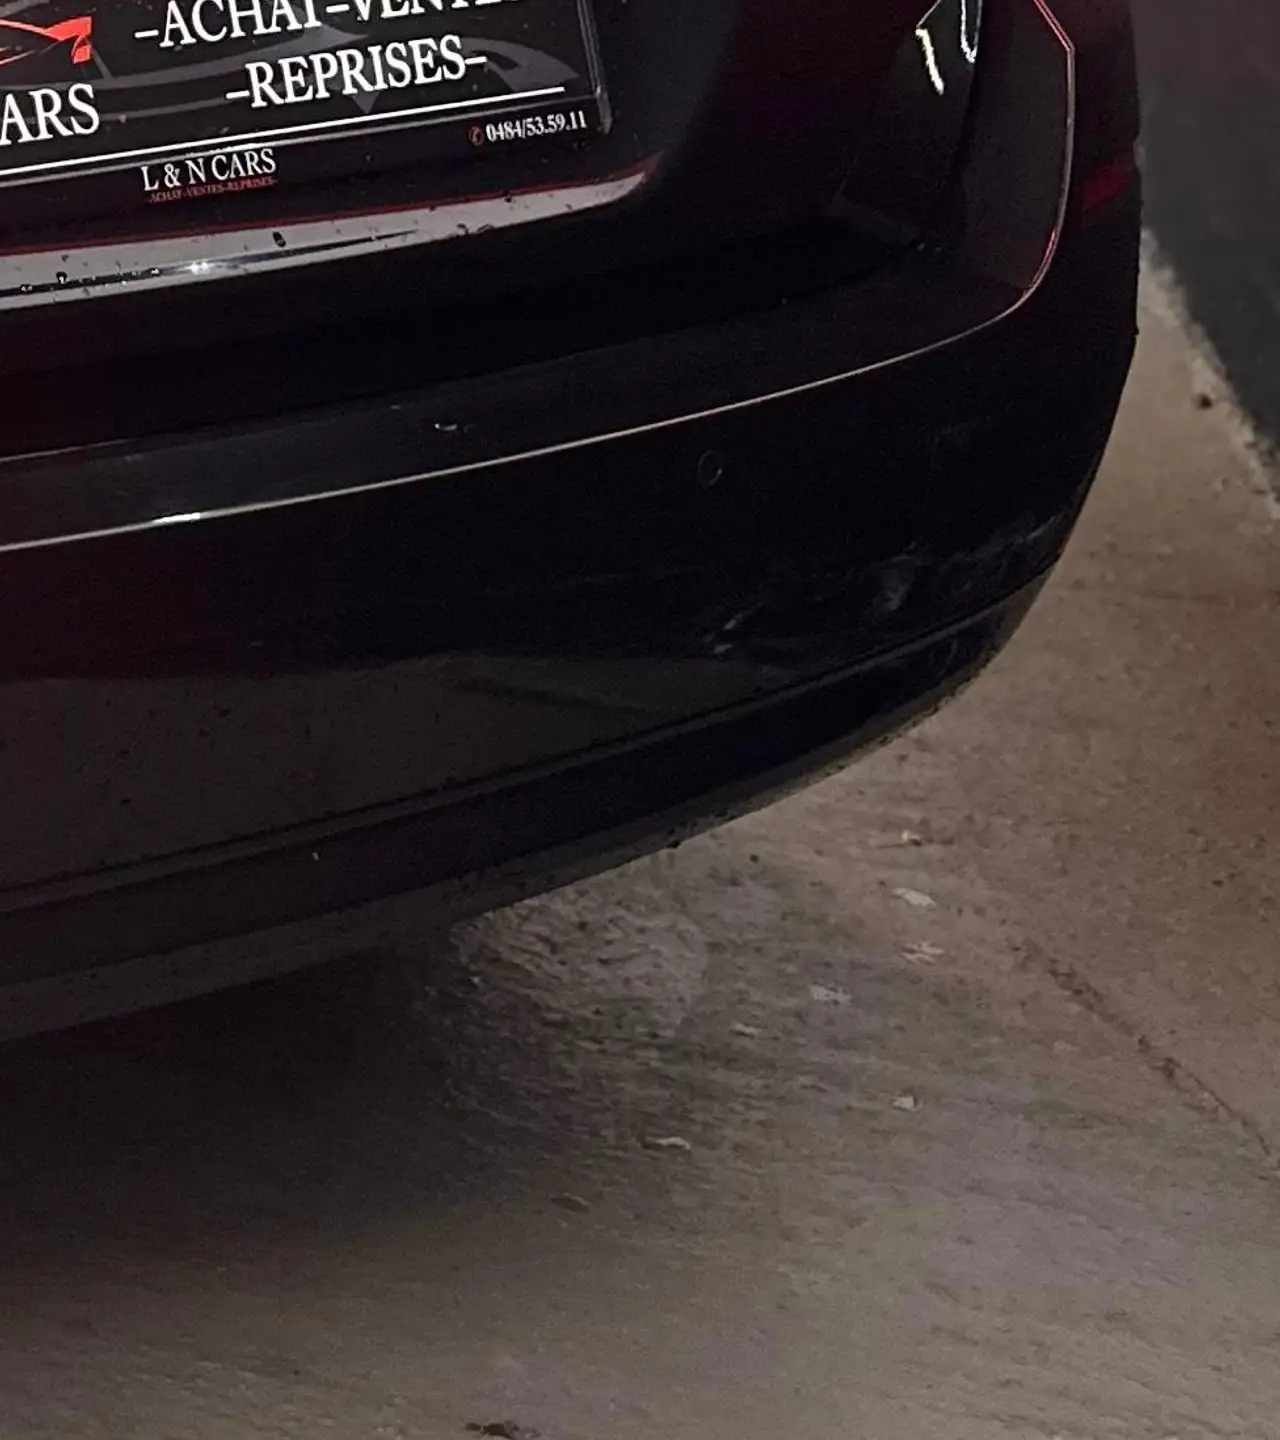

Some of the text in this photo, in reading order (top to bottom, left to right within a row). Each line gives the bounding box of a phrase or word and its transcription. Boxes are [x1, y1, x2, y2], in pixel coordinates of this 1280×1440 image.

[141, 148, 277, 192] L & N CARS
